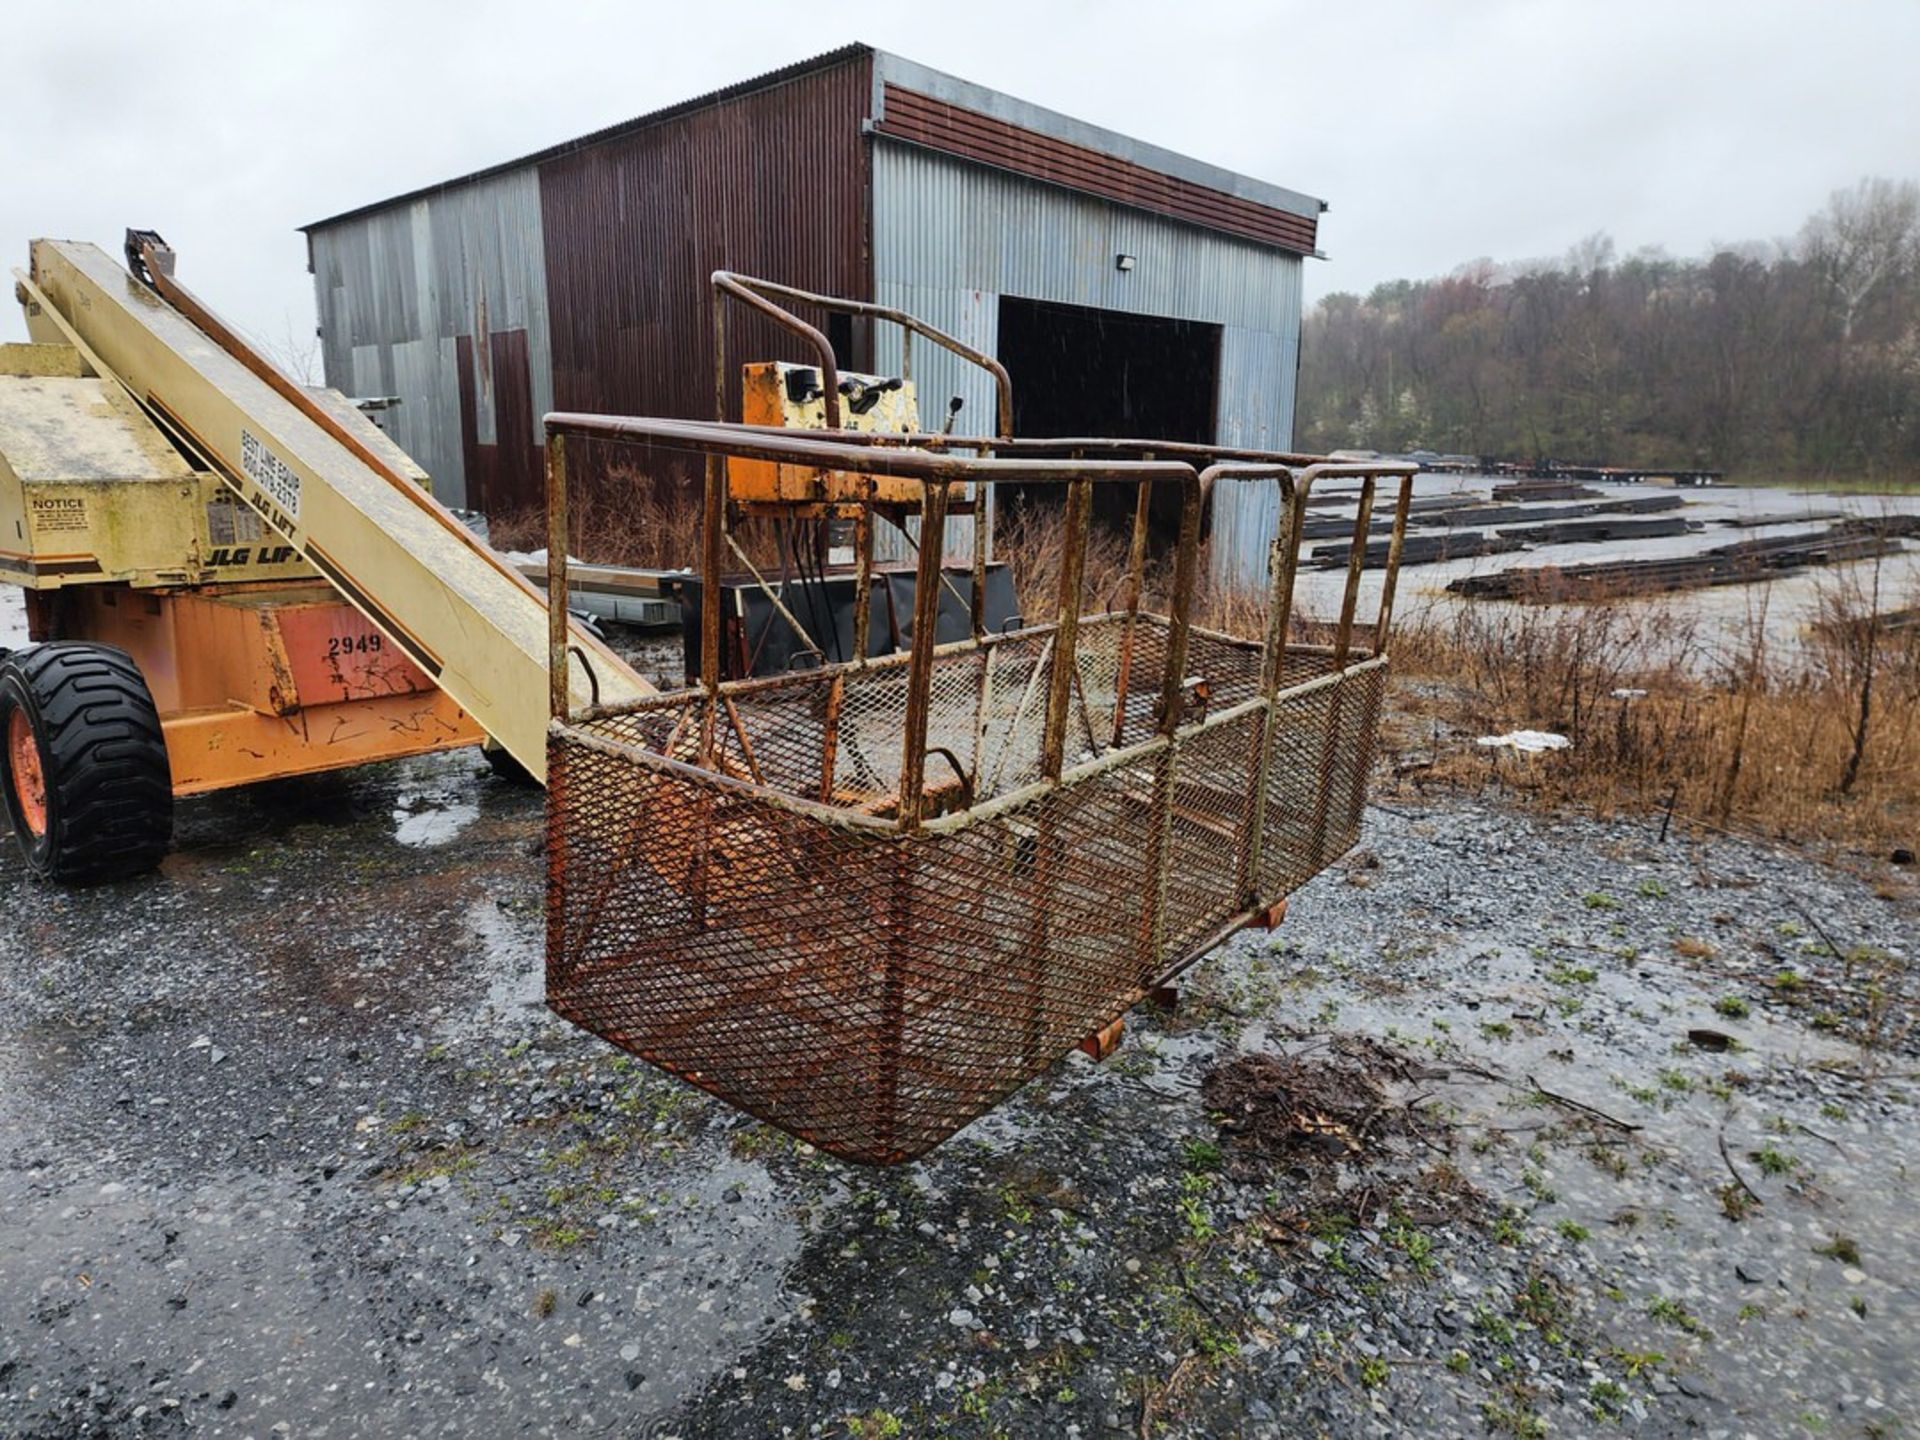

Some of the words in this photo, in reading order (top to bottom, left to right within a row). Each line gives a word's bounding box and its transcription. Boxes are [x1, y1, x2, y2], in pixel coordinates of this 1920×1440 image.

[242, 429, 259, 459] BEST
[260, 443, 276, 475] LINE
[33, 499, 84, 509] NOTICE
[251, 492, 270, 516] JLG
[272, 509, 296, 539] LIFT
[204, 549, 251, 566] JLG
[328, 634, 381, 657] 2949
